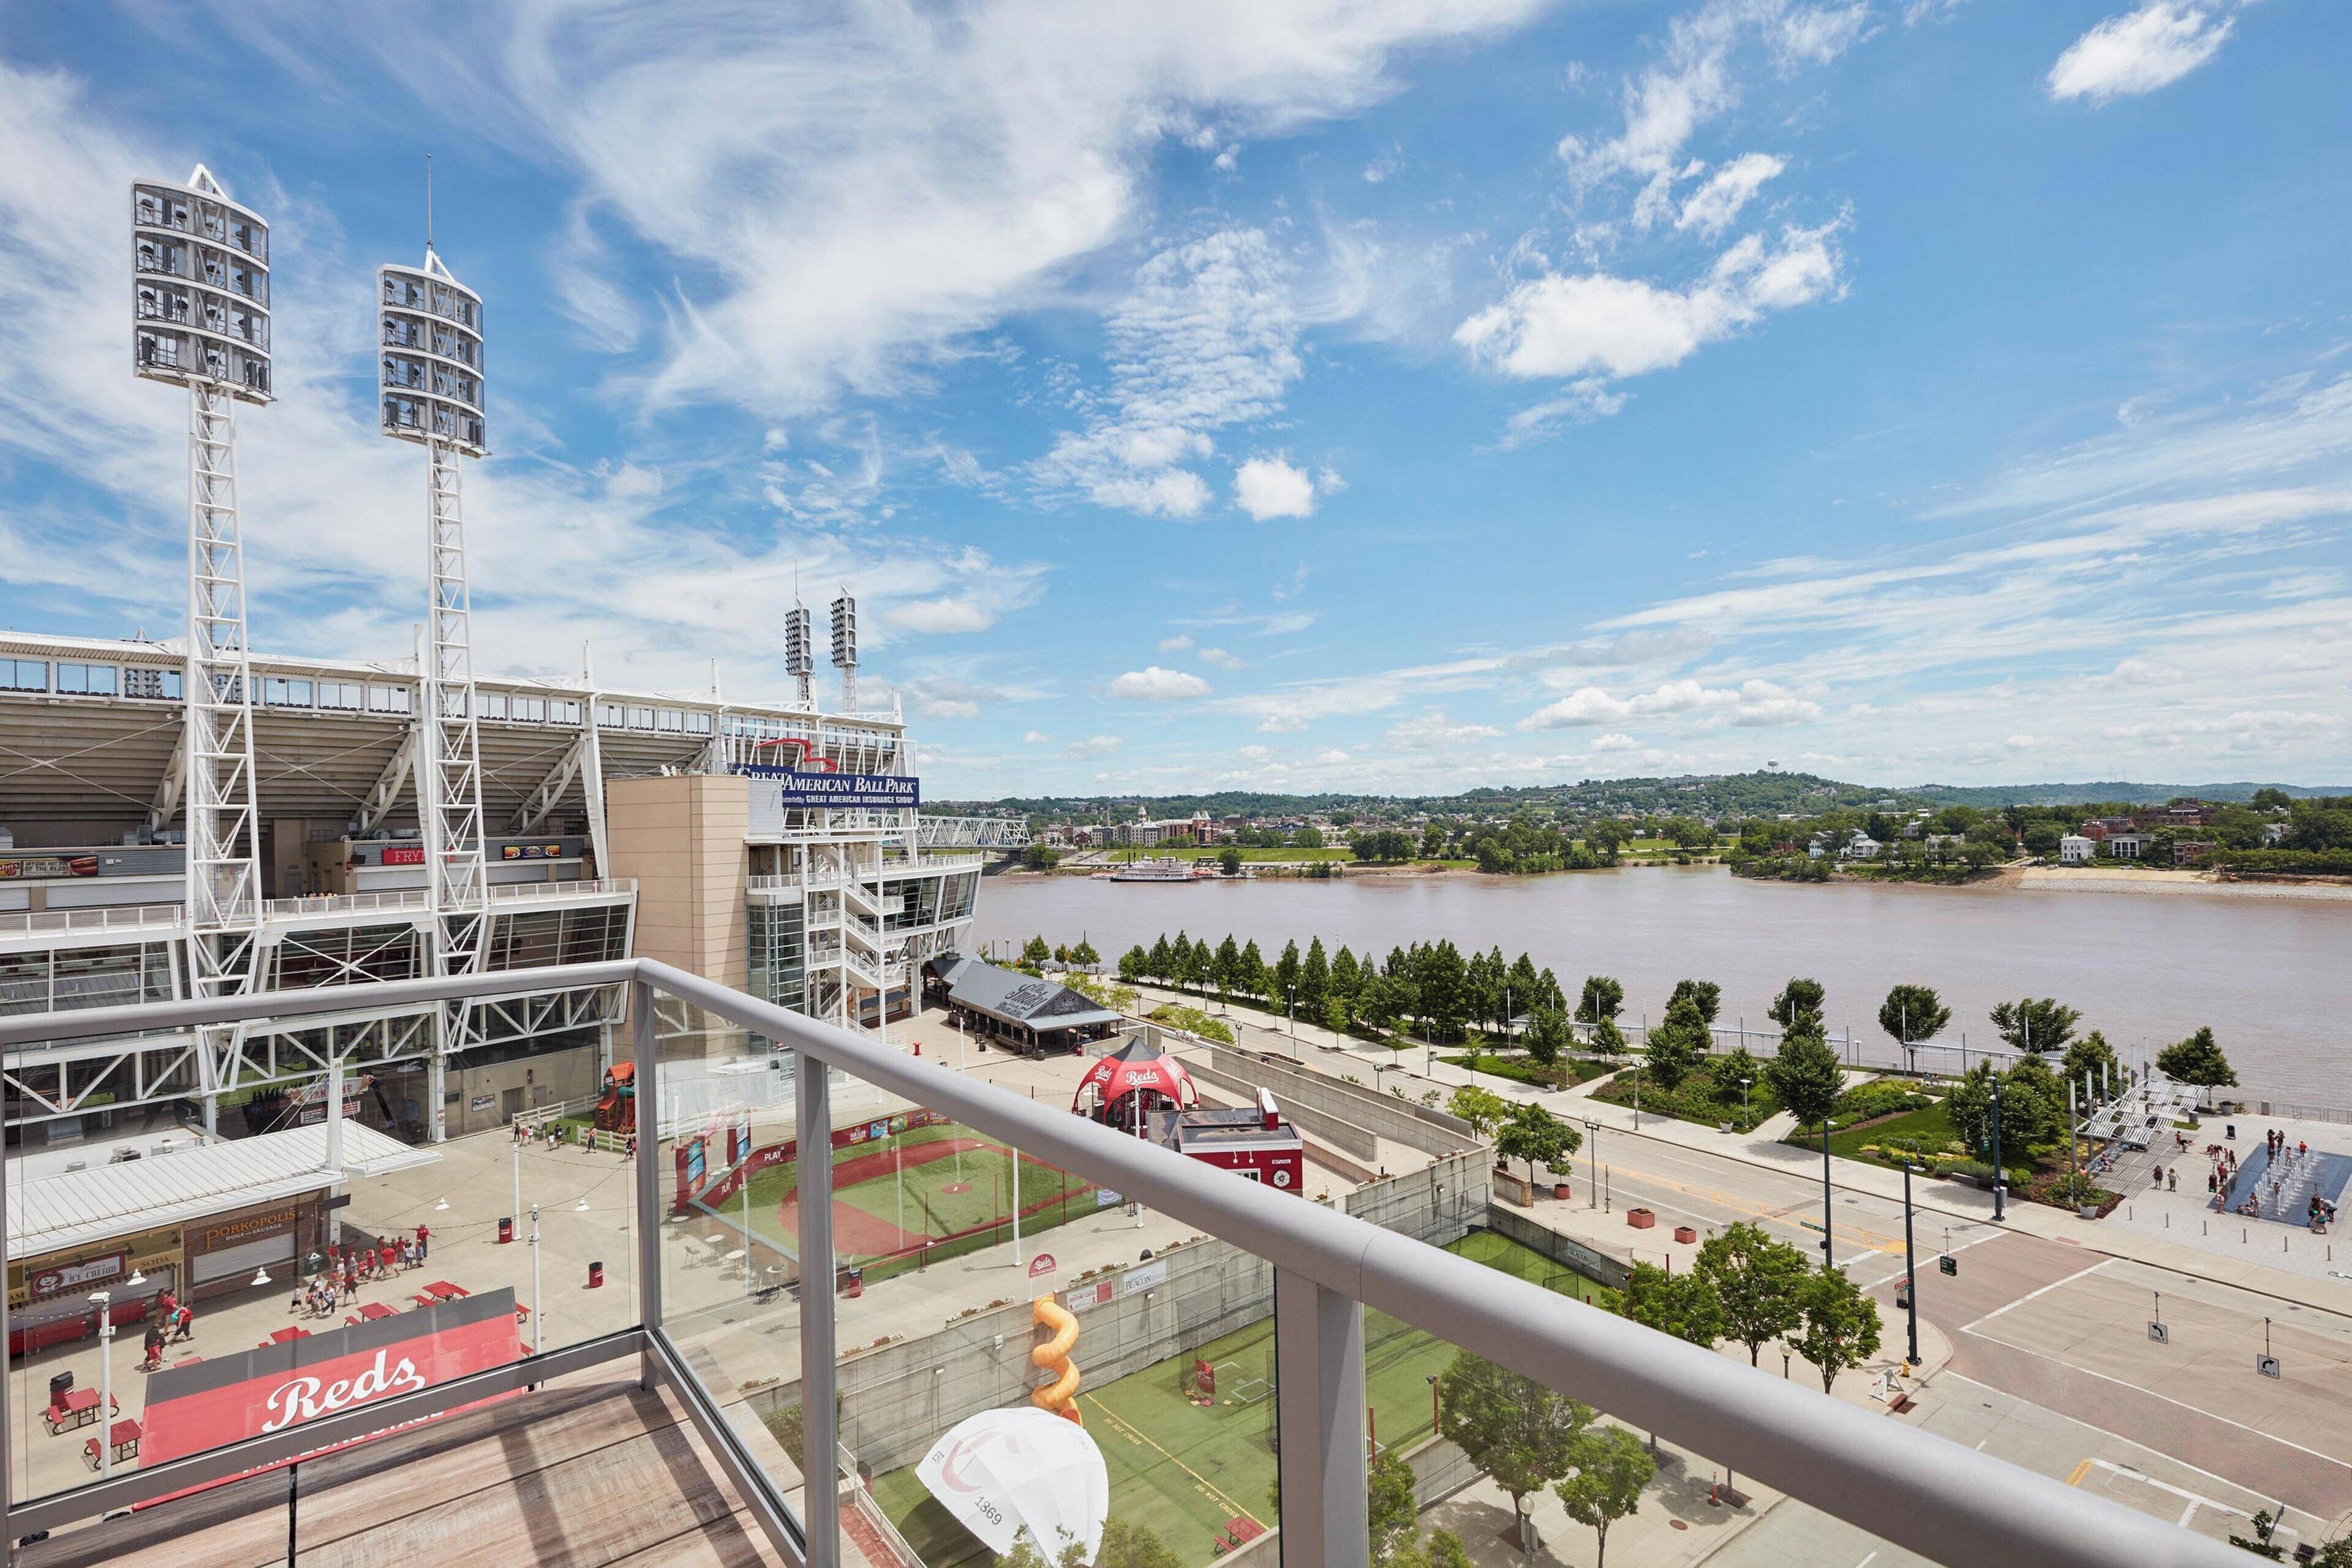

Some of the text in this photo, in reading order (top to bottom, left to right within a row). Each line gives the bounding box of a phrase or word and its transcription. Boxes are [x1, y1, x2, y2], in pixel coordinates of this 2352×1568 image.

[783, 774, 850, 791] AMERICAN
[1095, 1065, 1112, 1081] Reds
[1126, 1068, 1159, 1085] Reds
[764, 1151, 782, 1161] PLAY
[206, 1210, 296, 1250] PORKOPOLIS
[226, 1232, 244, 1241] DOGS
[252, 1223, 282, 1234] SAUSAGE
[141, 1256, 169, 1267] SODA
[69, 1265, 116, 1283] ICE CREAM
[1126, 1274, 1152, 1290] BEACON
[262, 1349, 426, 1433] Reds
[1194, 1484, 1240, 1518] DO NOT CROSS
[974, 1496, 1003, 1526] 1869
